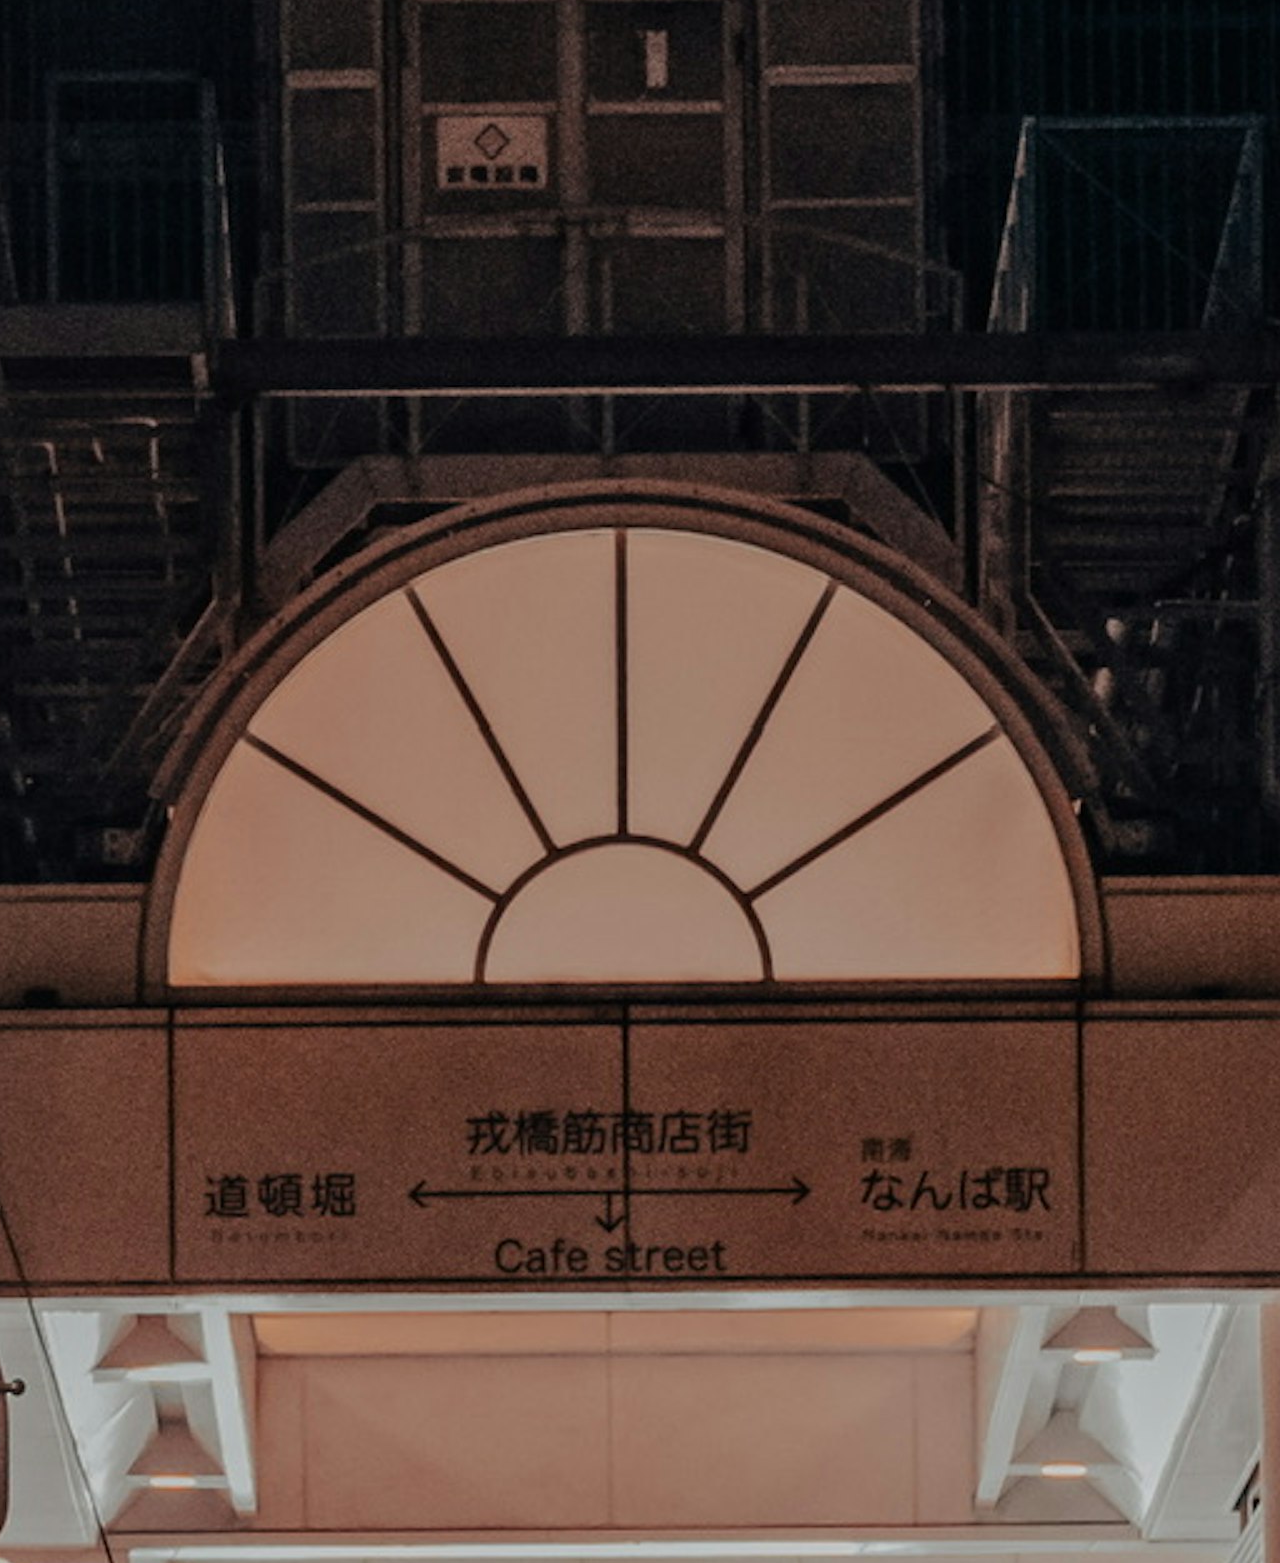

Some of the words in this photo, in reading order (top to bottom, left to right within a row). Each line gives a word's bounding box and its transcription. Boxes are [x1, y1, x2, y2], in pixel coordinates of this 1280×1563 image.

[466, 1110, 753, 1155] 戎橋筋商店街
[204, 1173, 357, 1217] 道頓堀
[860, 1166, 1051, 1212] なんば駅
[495, 1238, 588, 1274] Cafe
[604, 1239, 728, 1274] street
